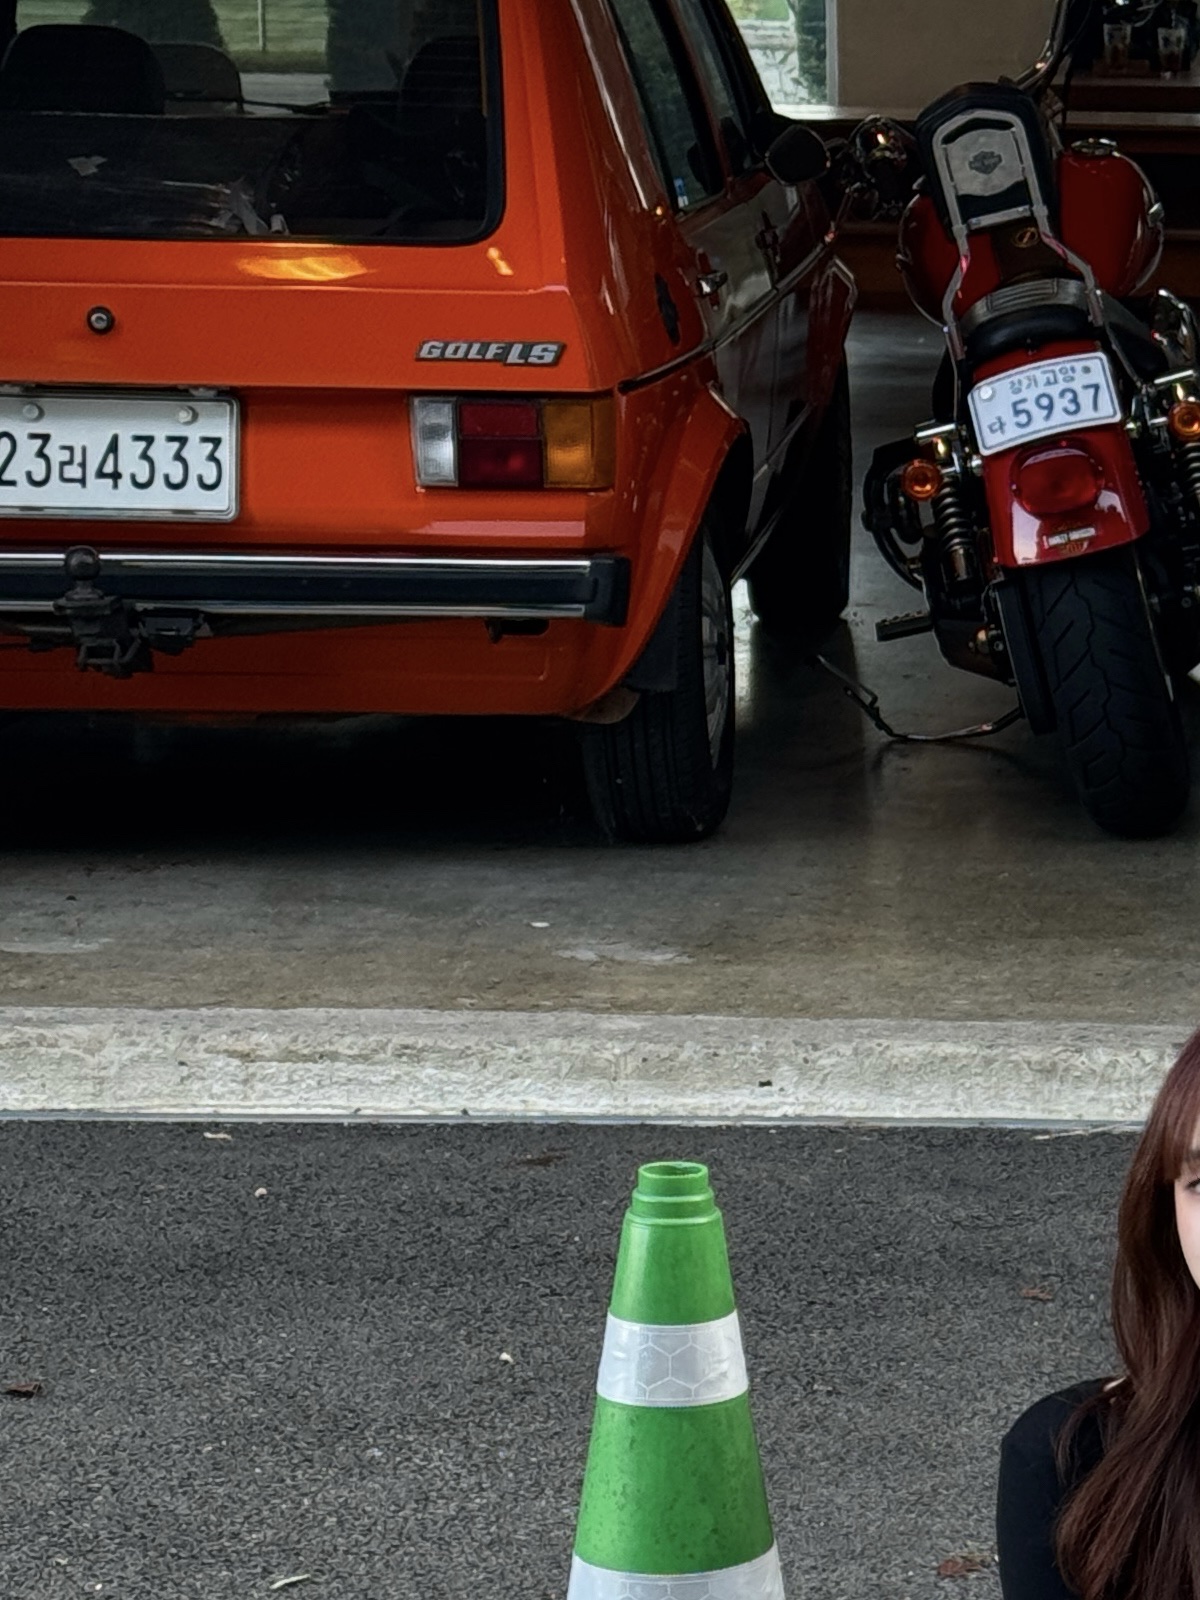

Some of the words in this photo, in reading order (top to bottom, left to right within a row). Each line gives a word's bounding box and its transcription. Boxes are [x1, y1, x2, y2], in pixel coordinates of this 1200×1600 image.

[419, 341, 506, 360] GOLF
[506, 343, 558, 364] LS
[1011, 383, 1100, 429] 5937
